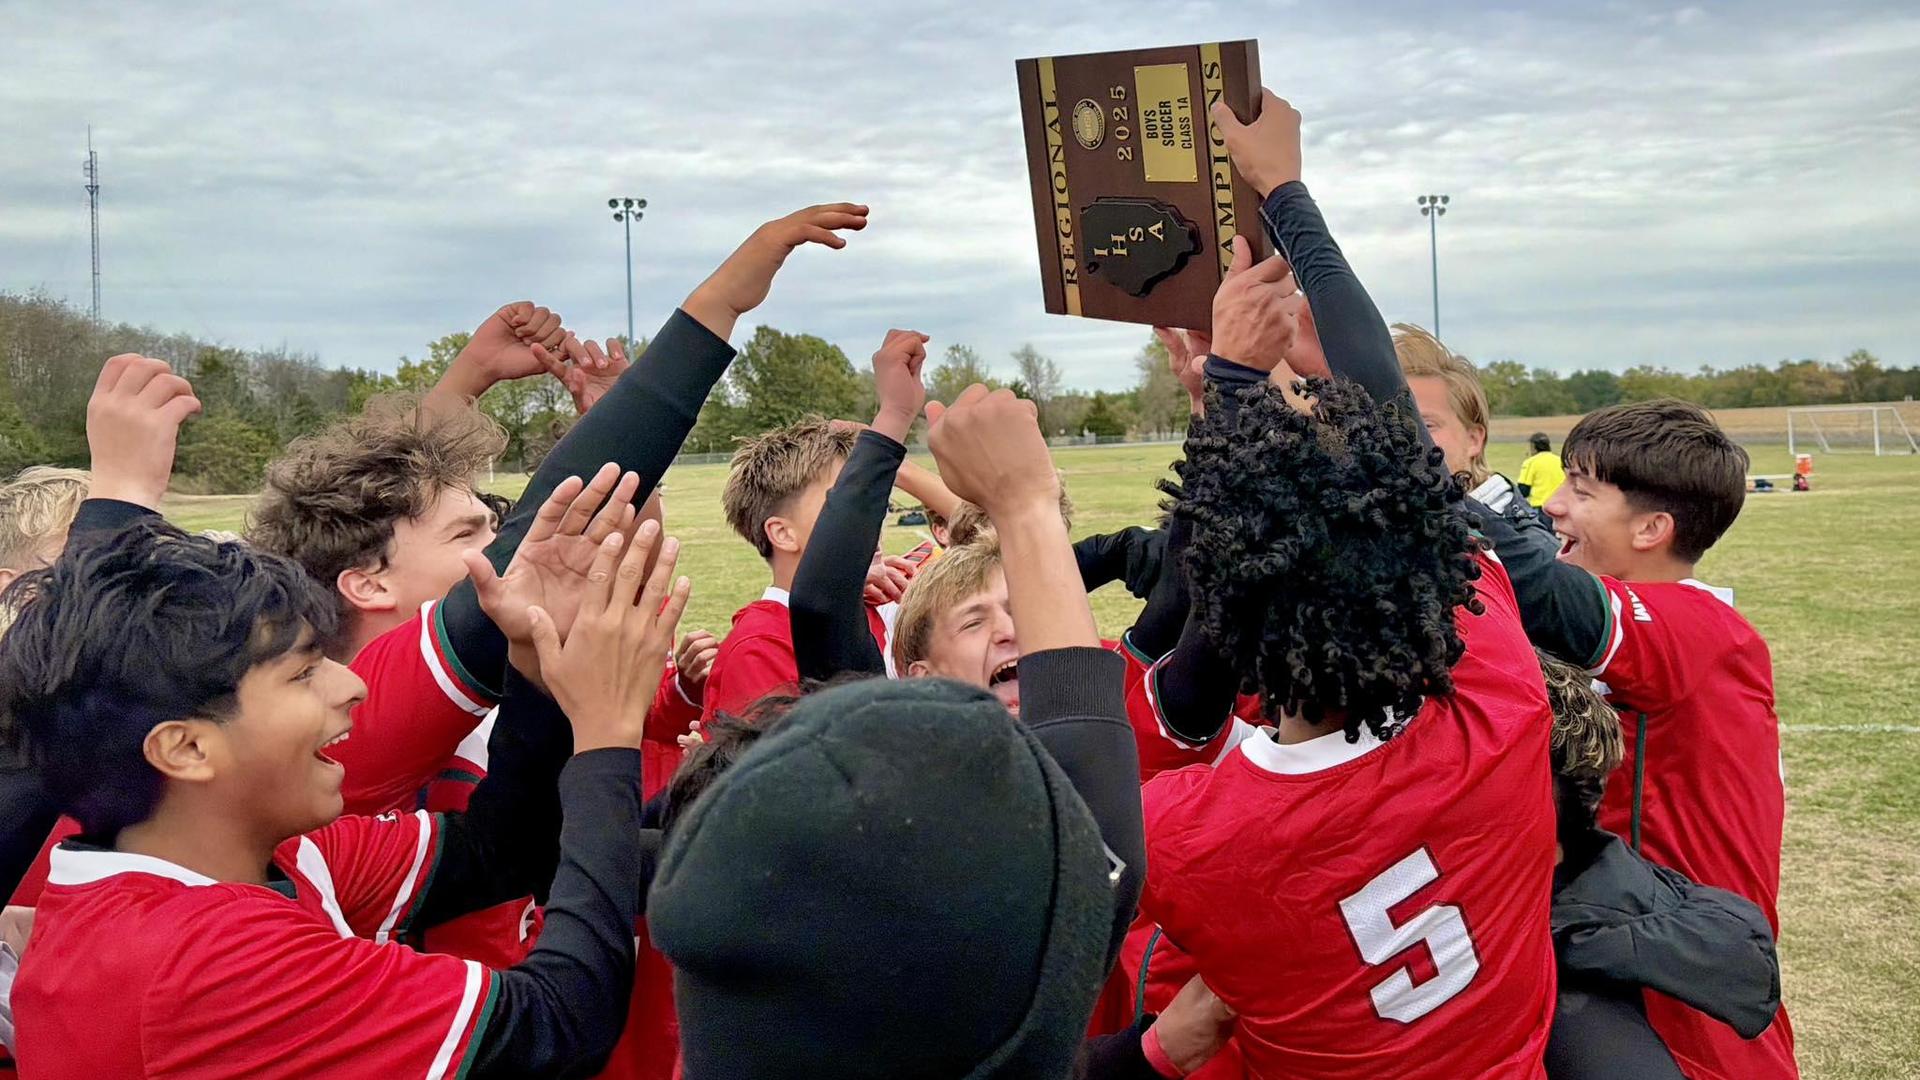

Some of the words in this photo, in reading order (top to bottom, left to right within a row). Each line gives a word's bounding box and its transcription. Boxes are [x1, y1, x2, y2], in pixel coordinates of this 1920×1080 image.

[1110, 85, 1133, 161] 2025
[1144, 109, 1159, 139] BOYS
[1158, 100, 1175, 147] SOCCER
[1176, 96, 1189, 109] 1A
[1178, 116, 1193, 149] CLASS
[1044, 88, 1078, 286] REGIONAL
[1204, 61, 1236, 274] AMPIONS
[1338, 846, 1480, 1023] 5
